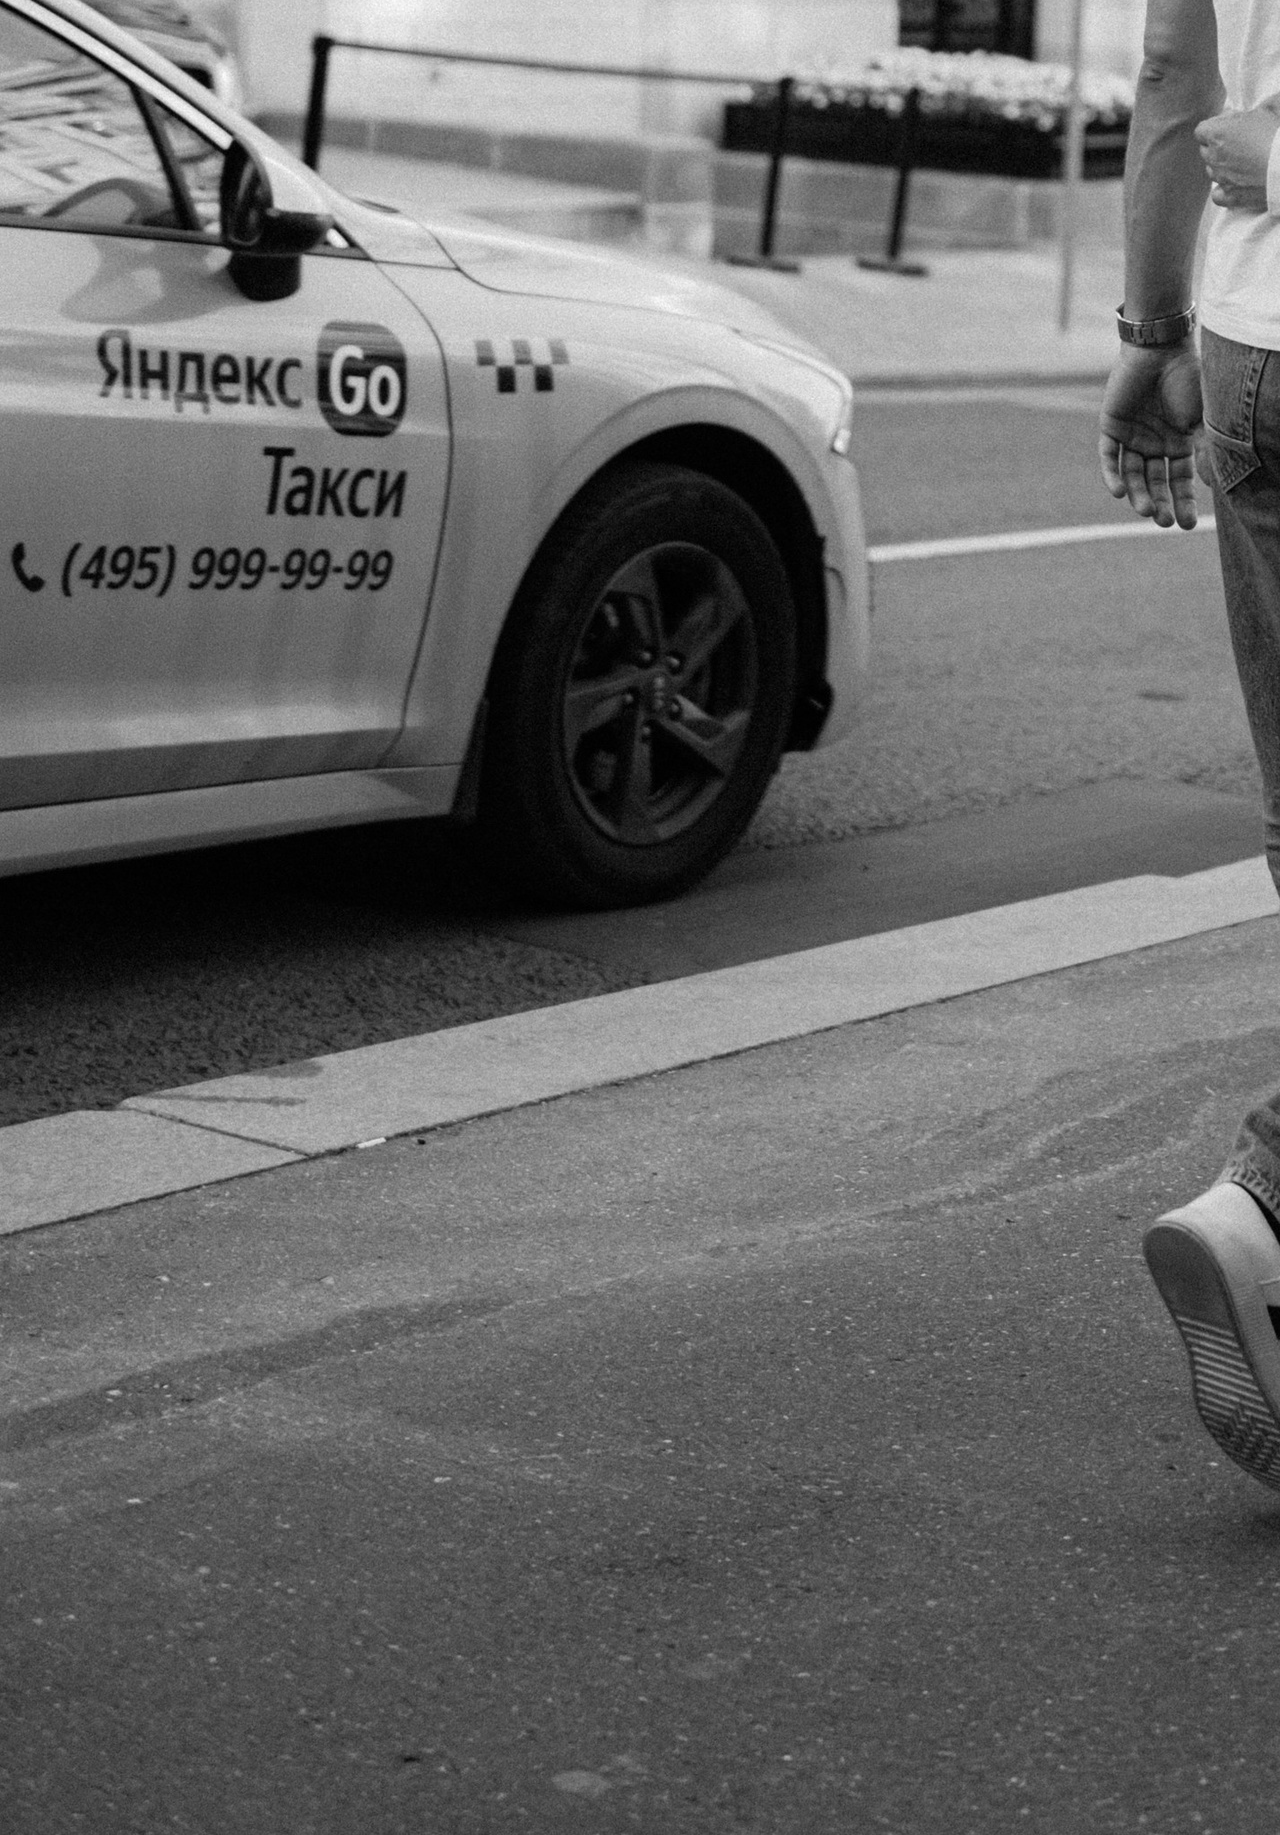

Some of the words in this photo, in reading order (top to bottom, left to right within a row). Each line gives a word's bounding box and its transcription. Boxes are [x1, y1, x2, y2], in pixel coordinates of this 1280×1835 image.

[97, 328, 303, 414] Яндекс
[329, 344, 401, 417] Go
[263, 446, 407, 518] Такси
[61, 542, 176, 597] (495)
[188, 547, 393, 591] 999-99-99
